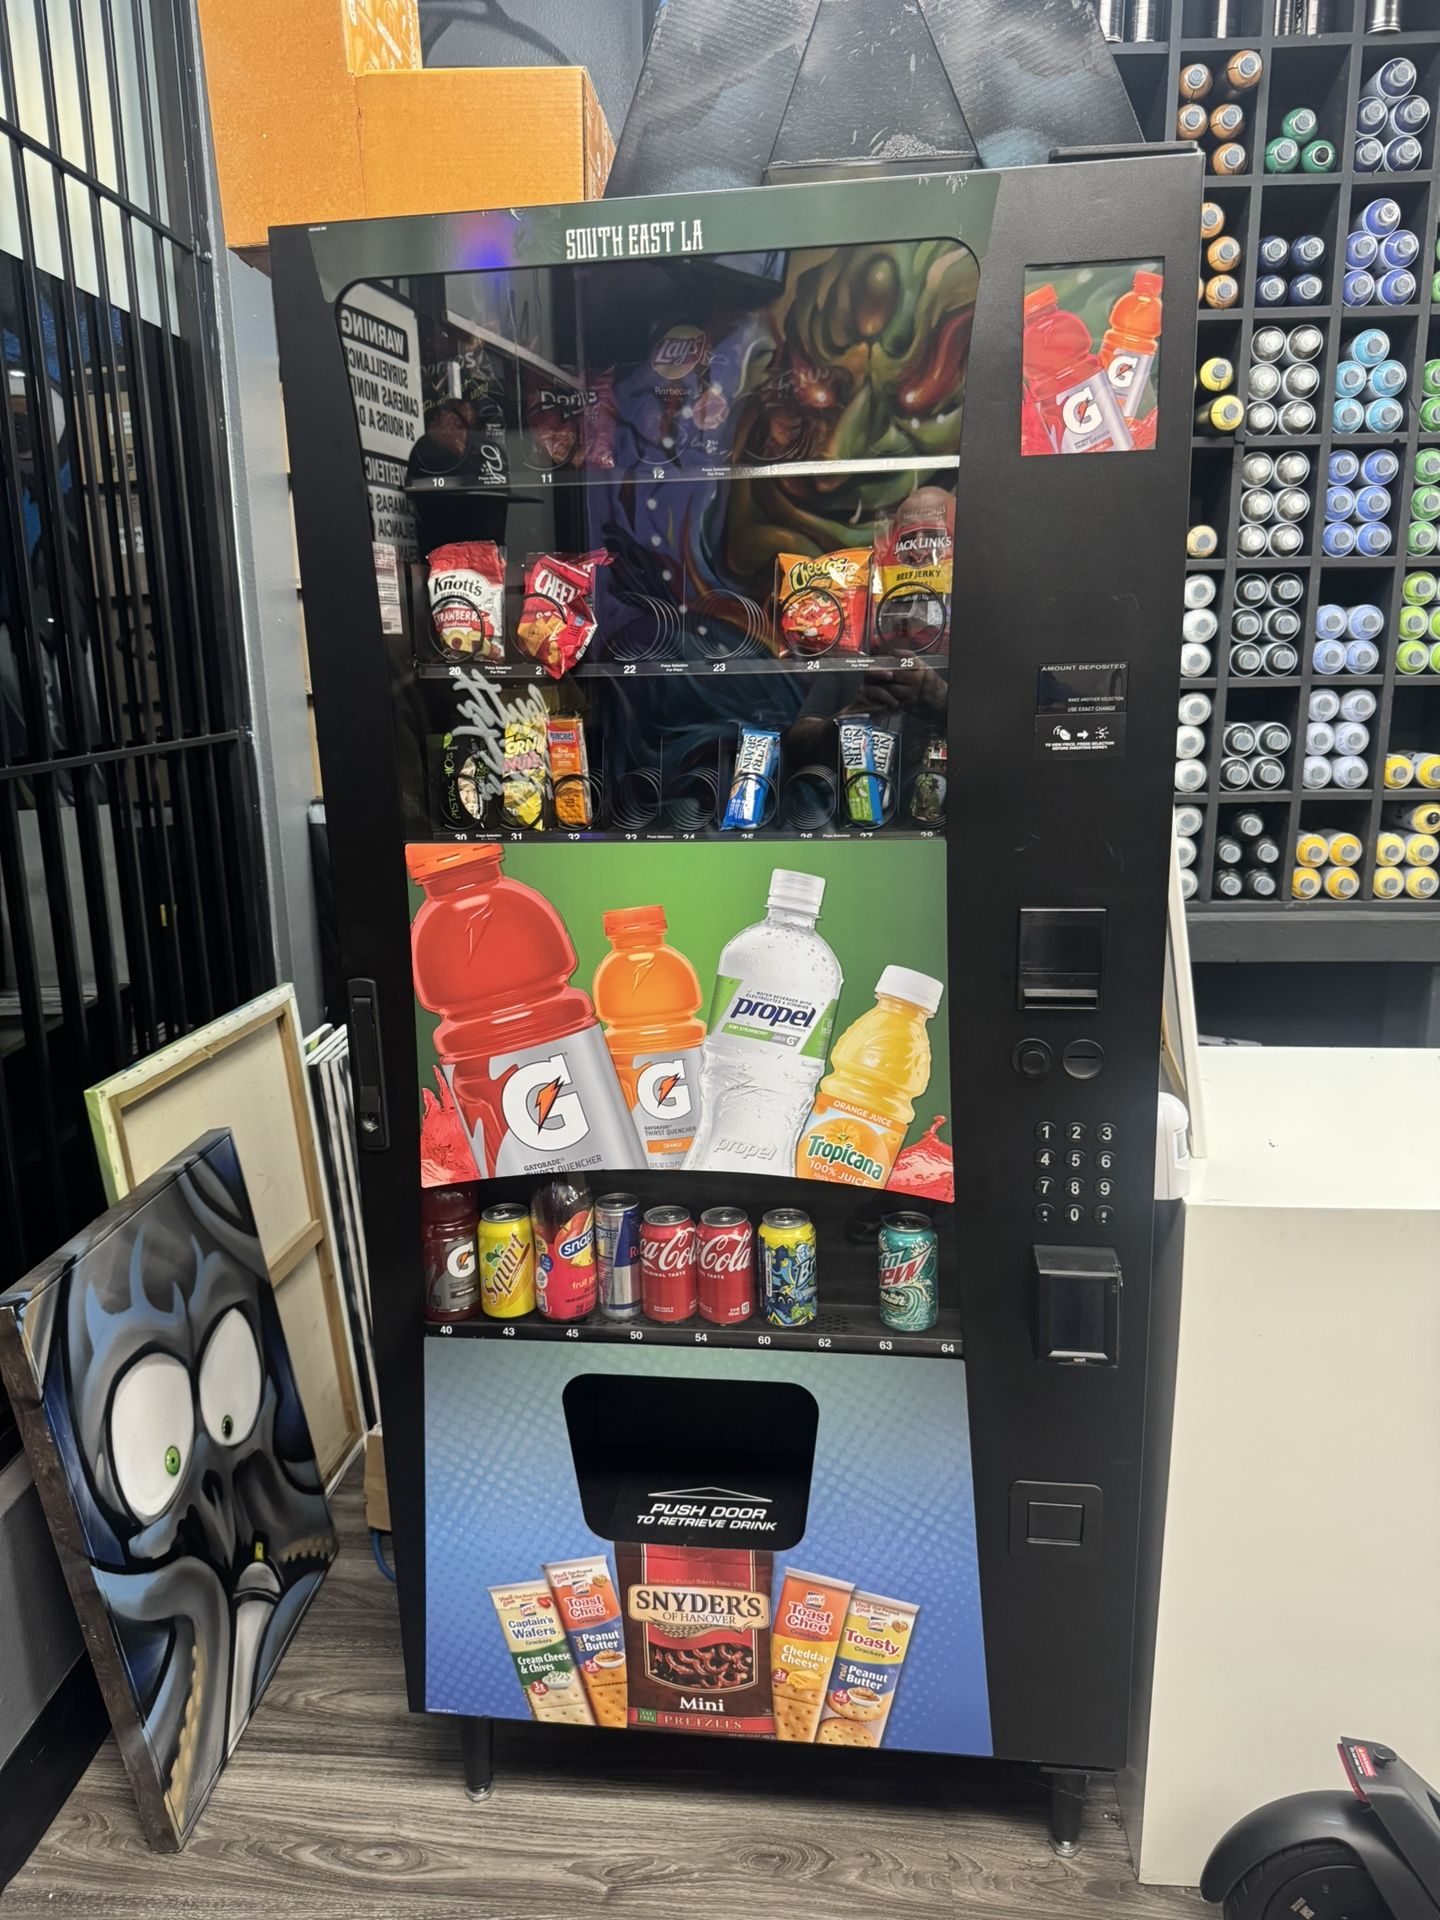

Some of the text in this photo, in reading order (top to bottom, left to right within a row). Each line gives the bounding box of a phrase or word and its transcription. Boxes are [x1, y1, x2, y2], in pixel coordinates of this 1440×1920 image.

[566, 219, 703, 260] SOUTH EAST LA
[655, 338, 701, 366] Lay's
[1108, 355, 1138, 387] G
[654, 386, 693, 397] Barbecue
[1063, 387, 1103, 434] G
[540, 473, 553, 484] 11
[653, 470, 665, 480] 12
[432, 478, 445, 487] 10
[895, 540, 918, 555] JACK
[895, 568, 941, 582] BEEF JERKY
[434, 575, 482, 597] Knott's
[432, 609, 481, 626] STRAWBERR
[713, 663, 726, 672] 23
[807, 660, 820, 670] 24
[901, 658, 914, 667] 25
[449, 666, 461, 676] 20
[623, 665, 636, 675] 22
[742, 735, 758, 772] GRAIN
[843, 727, 854, 766] GRAIN
[852, 728, 863, 766] NUTRI
[752, 736, 768, 773] NUTRI
[875, 736, 891, 775] NUTR
[745, 993, 782, 1004] ELECTROLYTES
[786, 1002, 810, 1010] VITAMINS
[773, 994, 799, 1003] BEVERAGE
[730, 997, 816, 1028] propel
[637, 1059, 692, 1120] G
[502, 1053, 591, 1151] G
[833, 1100, 893, 1127] ORANGE JUICE
[1042, 1126, 1050, 1138] 1
[1072, 1127, 1081, 1139] 2
[1102, 1127, 1112, 1140] 3
[714, 1136, 777, 1161] propel
[524, 1158, 561, 1171] GATORADE
[556, 1155, 603, 1173] QUENCHER
[806, 1134, 884, 1181] Tropicana
[1041, 1153, 1050, 1166] 4
[1071, 1154, 1080, 1167] 5
[1101, 1155, 1111, 1168] 6
[808, 1160, 836, 1177] 100%
[838, 1168, 870, 1186] JUICE
[1041, 1181, 1049, 1193] 7
[1071, 1182, 1080, 1194] 8
[1100, 1183, 1110, 1195] 9
[1070, 1208, 1079, 1221] 0
[447, 1241, 476, 1278] G
[482, 1232, 525, 1304] Squirt
[668, 1270, 686, 1278] TASTE
[707, 1272, 726, 1280] TASTE
[572, 1280, 588, 1290] fruit
[440, 1326, 452, 1335] 40
[502, 1327, 516, 1336] 43
[566, 1329, 579, 1338] 45
[630, 1331, 643, 1340] 50
[694, 1333, 708, 1342] 54
[758, 1336, 771, 1346] 60
[818, 1338, 832, 1348] 62
[879, 1341, 892, 1350] 63
[941, 1344, 954, 1353] 64
[650, 1504, 767, 1520] PUSH DOOR
[636, 1515, 778, 1532] TO RETRIEVE DRINK
[566, 1594, 602, 1609] Toast
[636, 1590, 762, 1618] SNYDER'S
[570, 1605, 606, 1620] Chee
[662, 1612, 736, 1625] OF HANOVER
[789, 1602, 833, 1624] Toast
[508, 1616, 554, 1630] Captain's
[786, 1615, 830, 1635] Chee
[512, 1626, 557, 1640] Wafers
[583, 1630, 620, 1643] Peanut
[586, 1640, 619, 1652] Butter
[845, 1628, 900, 1655] Toasty
[518, 1652, 572, 1666] Cream Cheese
[783, 1645, 830, 1664] Cheddar
[855, 1646, 886, 1658] Crackers
[520, 1662, 555, 1674] & Chives
[781, 1654, 820, 1670] Cheese
[849, 1665, 889, 1684] Peanut
[846, 1674, 883, 1690] Butter
[680, 1696, 724, 1712] Mini
[664, 1716, 742, 1730] PRETZELS
